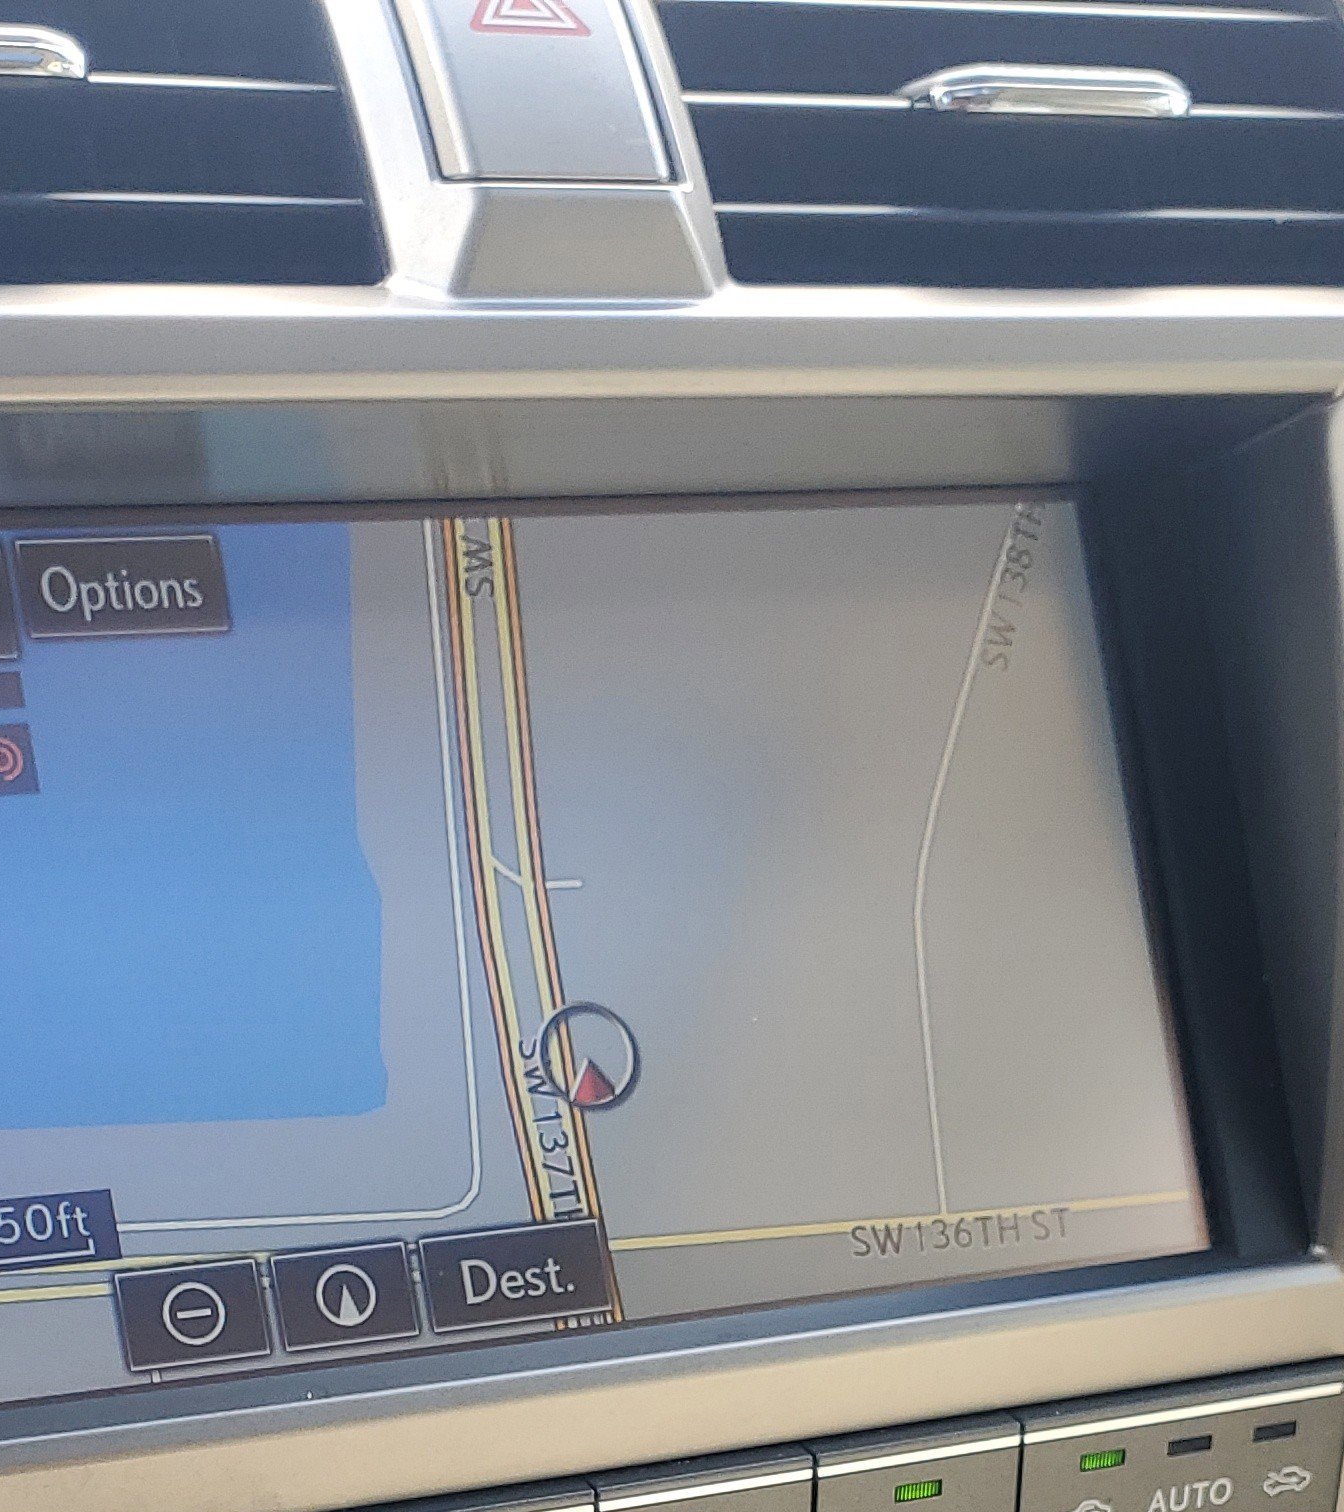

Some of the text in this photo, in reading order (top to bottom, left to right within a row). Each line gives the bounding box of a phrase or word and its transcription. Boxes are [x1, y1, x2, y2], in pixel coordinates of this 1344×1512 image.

[40, 565, 204, 622] Options
[983, 609, 1017, 672] SW
[851, 1207, 1070, 1257] SW 136TH ST
[459, 1256, 576, 1306] Dest.
